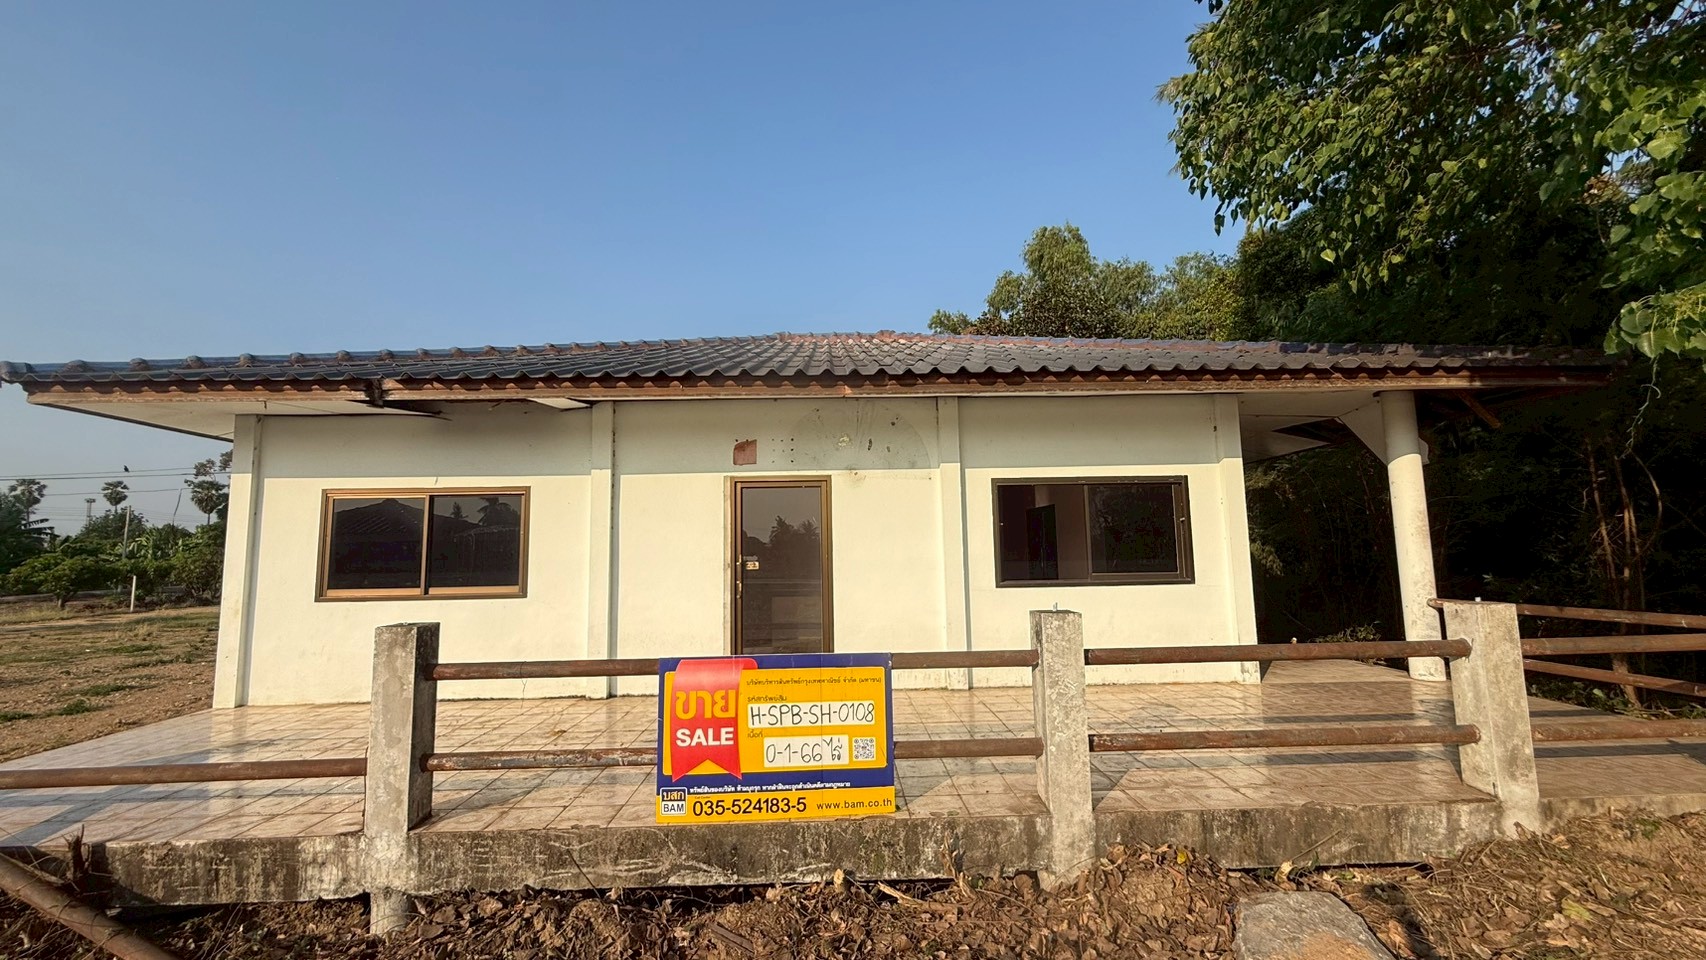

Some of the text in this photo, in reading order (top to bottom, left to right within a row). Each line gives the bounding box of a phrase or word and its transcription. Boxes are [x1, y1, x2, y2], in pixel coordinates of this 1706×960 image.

[675, 690, 736, 720] ขาย
[750, 703, 875, 726] H-SPB-SH-0108
[675, 727, 735, 747] SALE
[662, 790, 685, 800] บสก
[816, 798, 892, 809] www.bam.co.th
[663, 803, 685, 812] BAM
[692, 797, 807, 816] 035-524183-5
